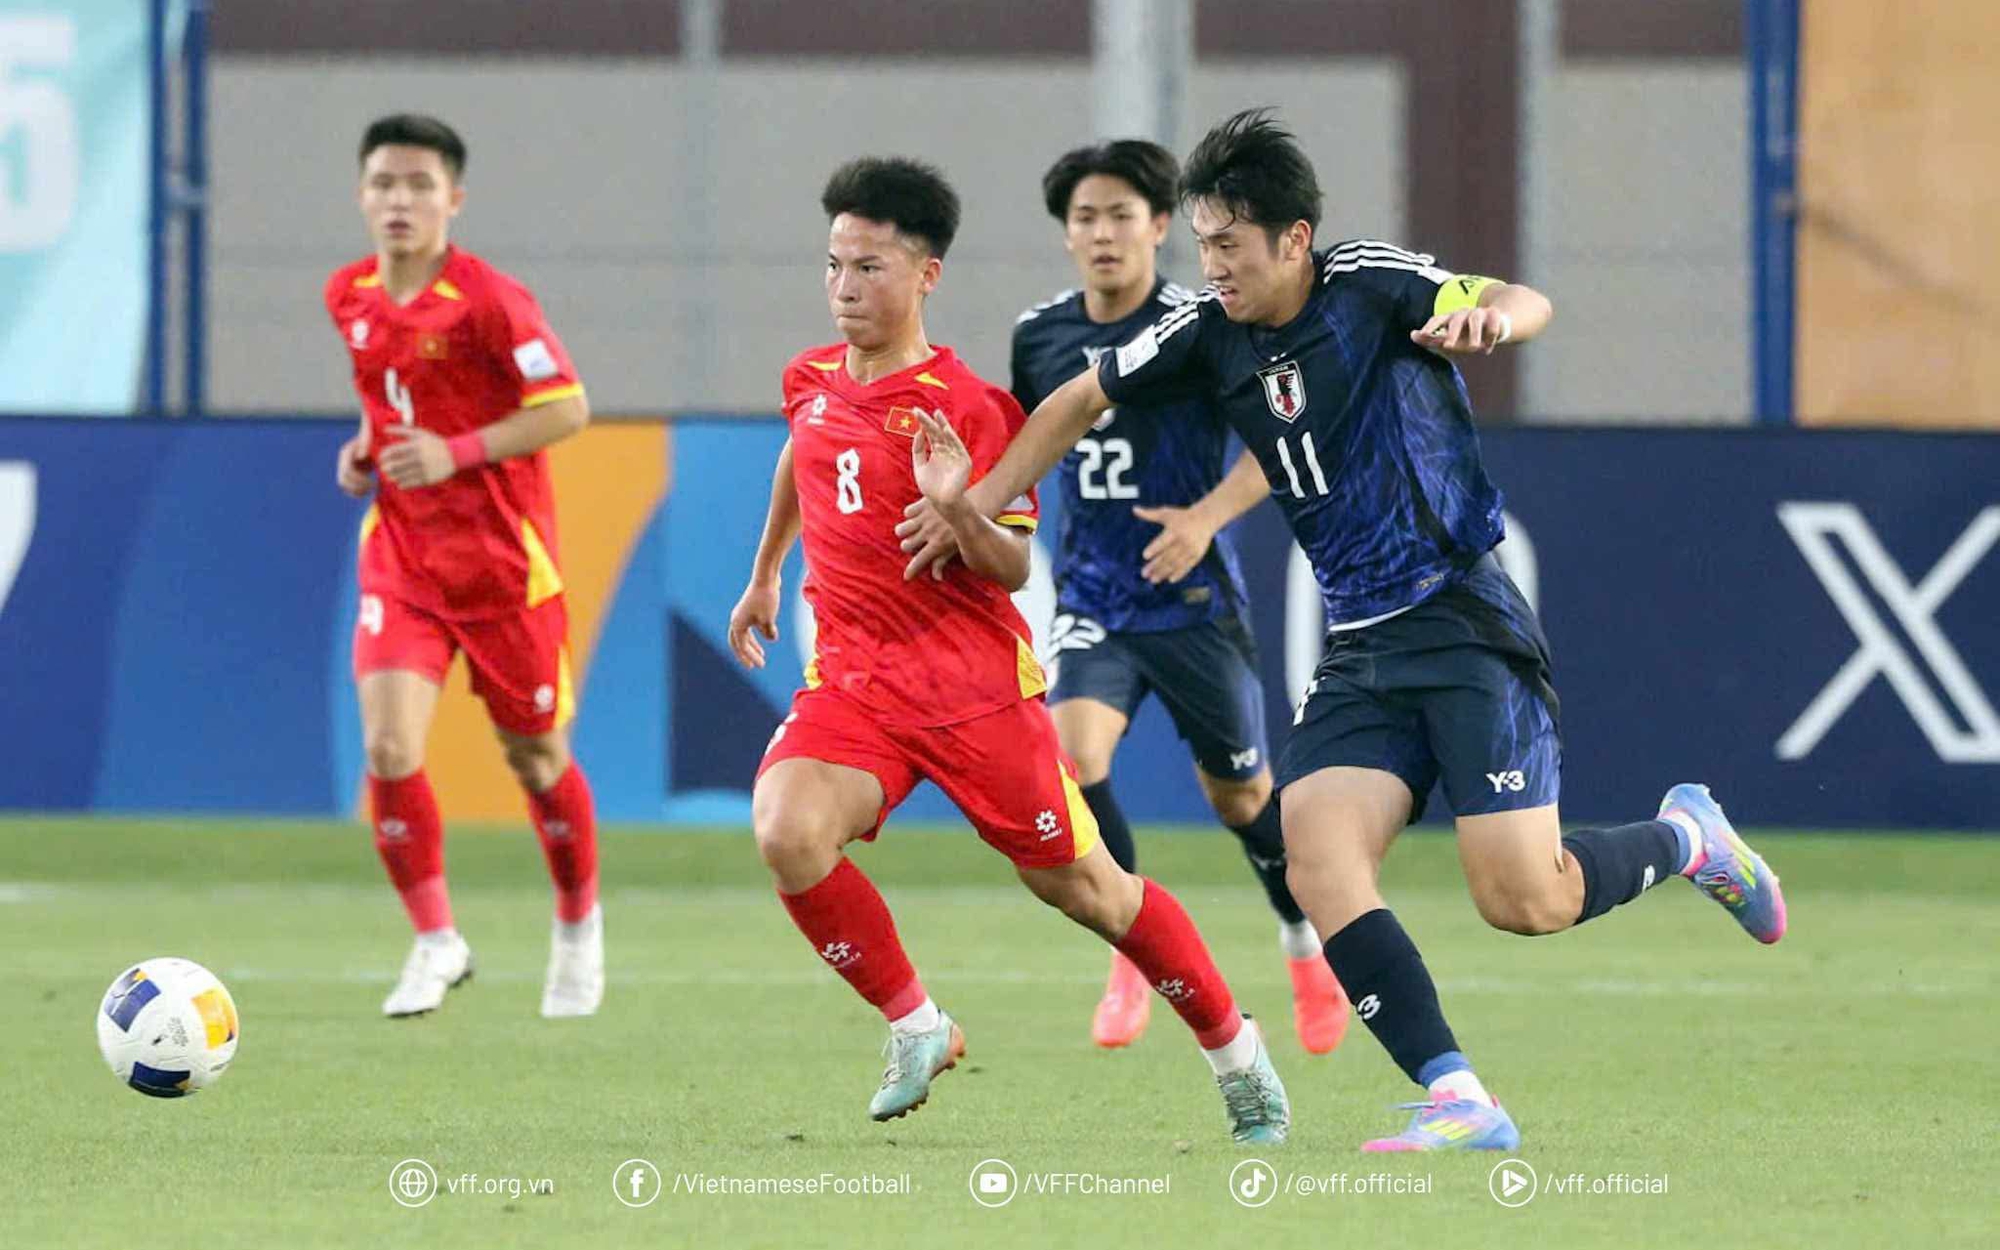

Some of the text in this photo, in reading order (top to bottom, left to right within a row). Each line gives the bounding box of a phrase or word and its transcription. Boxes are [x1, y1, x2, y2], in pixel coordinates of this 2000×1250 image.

[384, 366, 414, 428] 4
[836, 447, 864, 515] 8
[1074, 437, 1140, 500] 22
[1275, 430, 1330, 499] 11
[1773, 498, 2000, 763] X
[1485, 770, 1526, 794] Y-3
